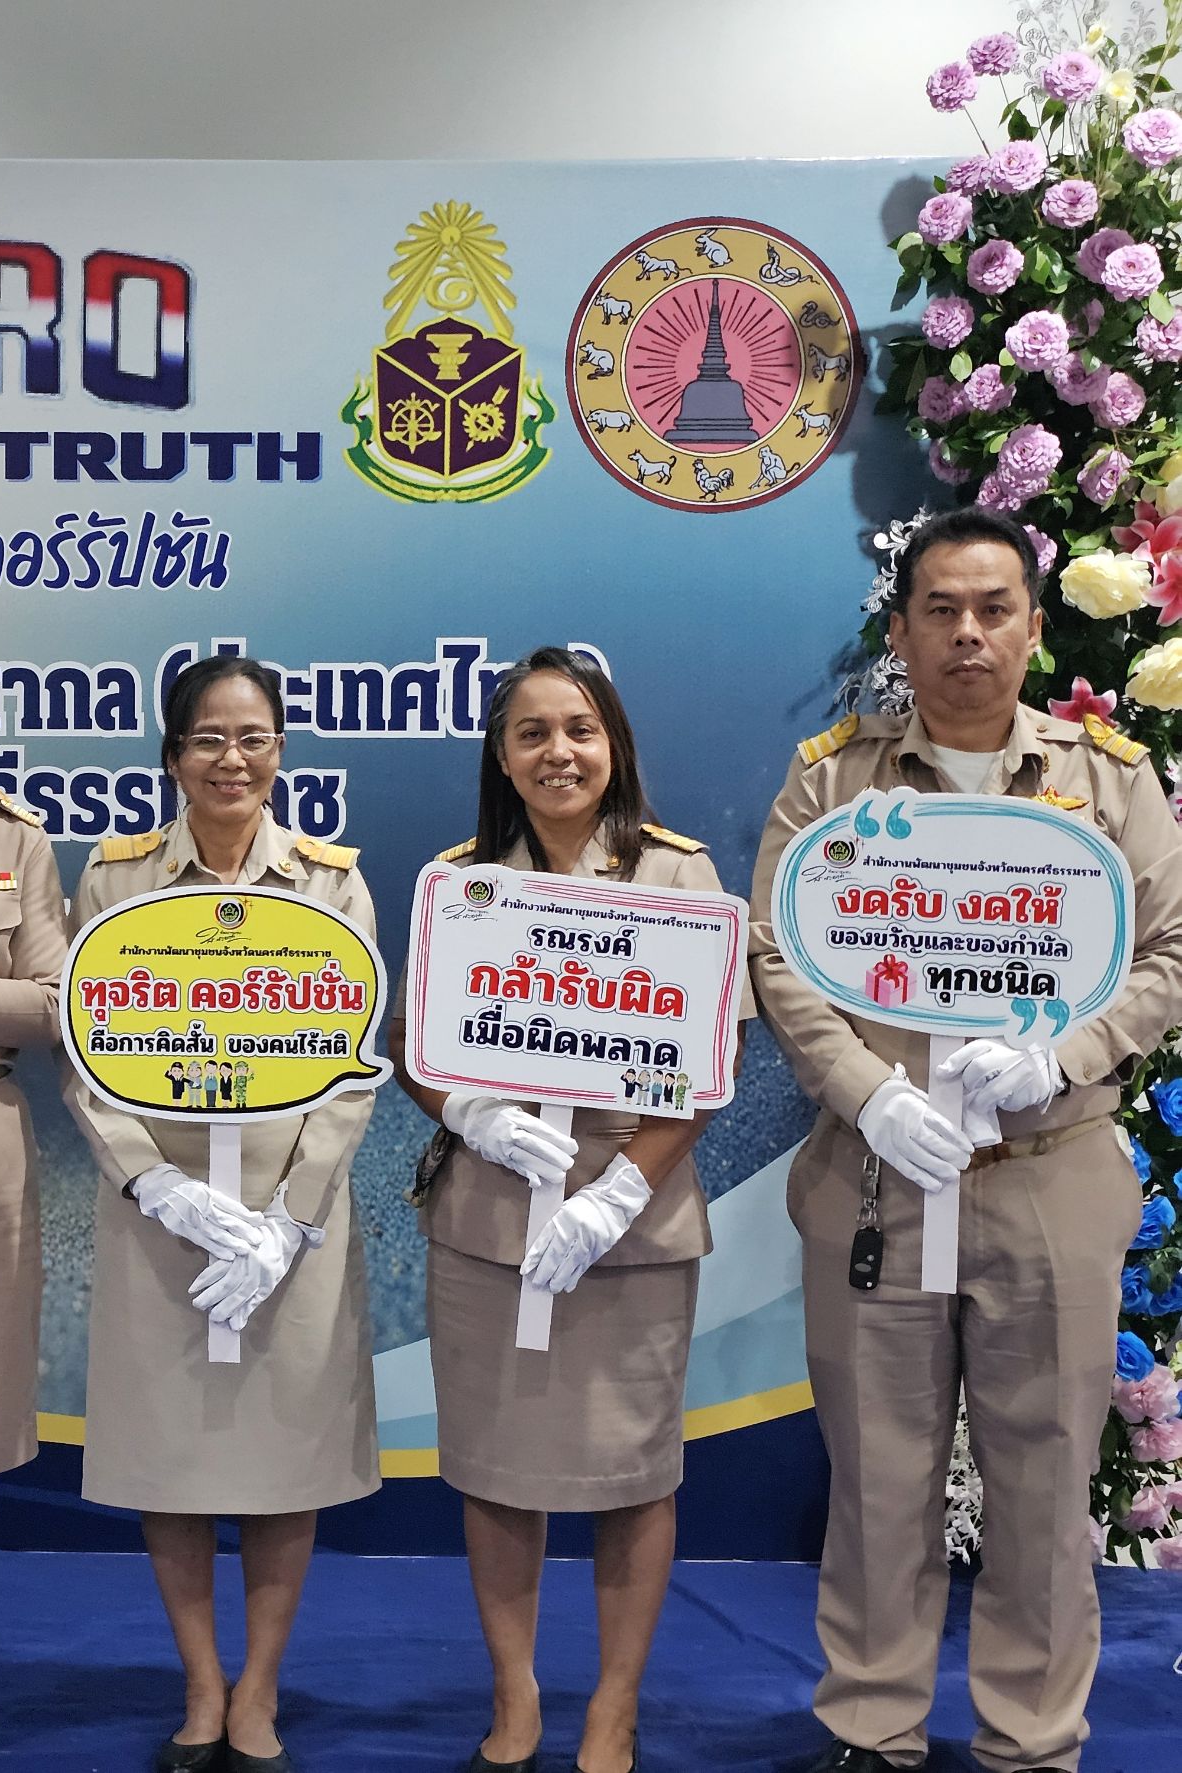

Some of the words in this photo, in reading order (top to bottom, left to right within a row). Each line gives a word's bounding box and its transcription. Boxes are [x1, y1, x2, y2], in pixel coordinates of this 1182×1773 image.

[835, 878, 943, 918] งดรับ
[956, 885, 1062, 925] งดให้
[531, 926, 637, 957] รณรงค์
[829, 926, 1069, 959] ของขวัญและของกำนัล
[81, 970, 178, 1021] ทุจริต
[191, 962, 363, 1011] คอร์รัปชั่น
[469, 955, 685, 1018] กล้ารับผิด
[926, 962, 1056, 1004] ทุกชนิด
[90, 1022, 214, 1053] คือการคิดสั้น
[227, 1032, 348, 1055] ของคนไร้สติ
[462, 1004, 679, 1068] เมื่อผิดพลาด
